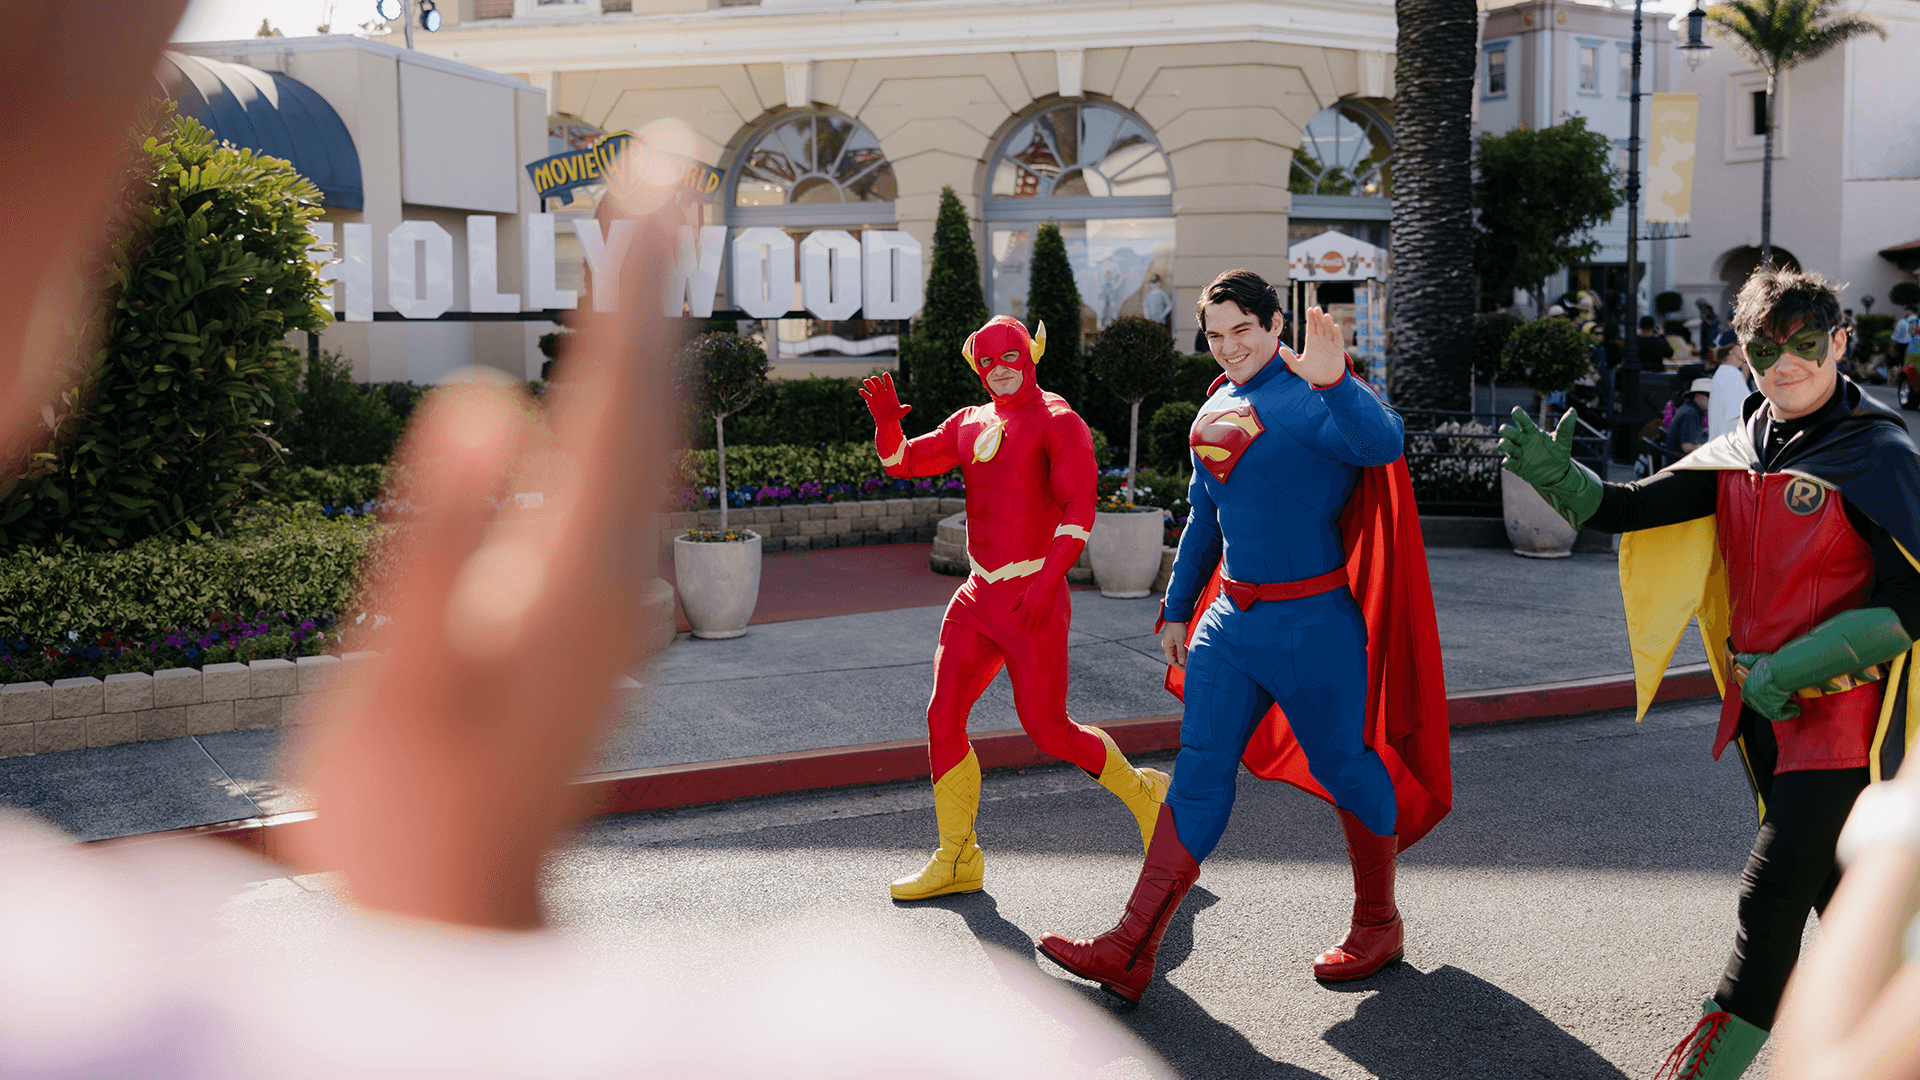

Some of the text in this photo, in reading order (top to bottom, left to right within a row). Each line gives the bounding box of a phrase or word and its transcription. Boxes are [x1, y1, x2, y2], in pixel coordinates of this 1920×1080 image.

[534, 152, 720, 195] MOVIE ORLD
[304, 212, 923, 322] HOLLYWOOD
[1790, 481, 1818, 510] R
